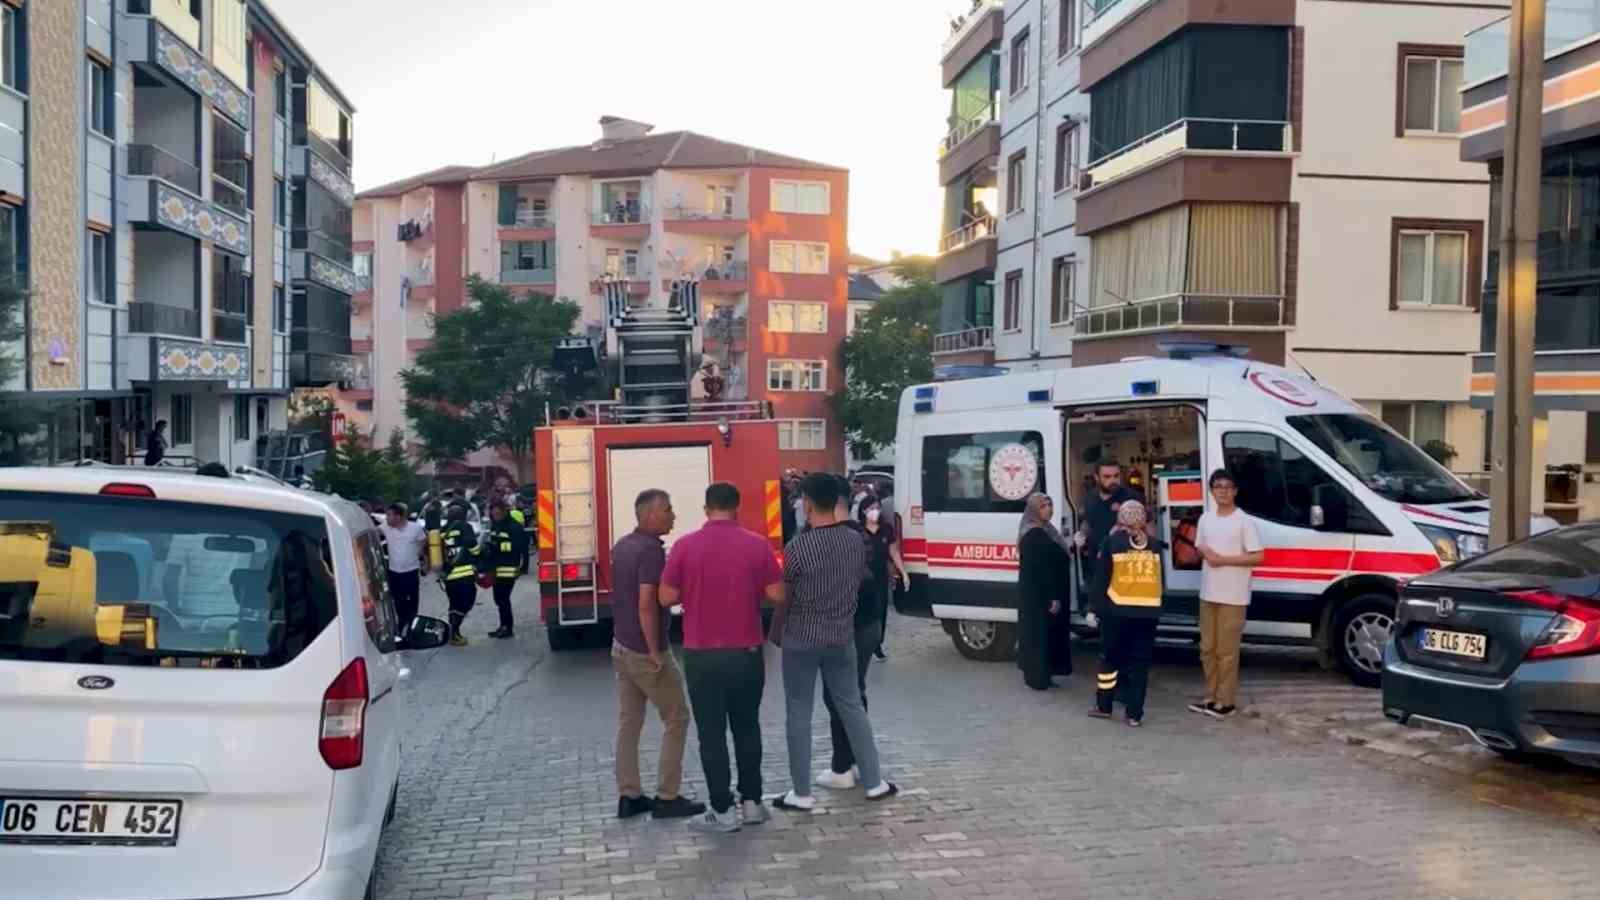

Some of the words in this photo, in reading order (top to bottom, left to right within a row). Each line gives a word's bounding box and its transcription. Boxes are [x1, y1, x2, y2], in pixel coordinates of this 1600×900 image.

[1128, 561, 1153, 576] 112
[1424, 631, 1436, 647] 06
[1464, 636, 1482, 654] 754
[3, 803, 38, 832] 06
[55, 804, 108, 833] CEN
[124, 805, 175, 834] 452
